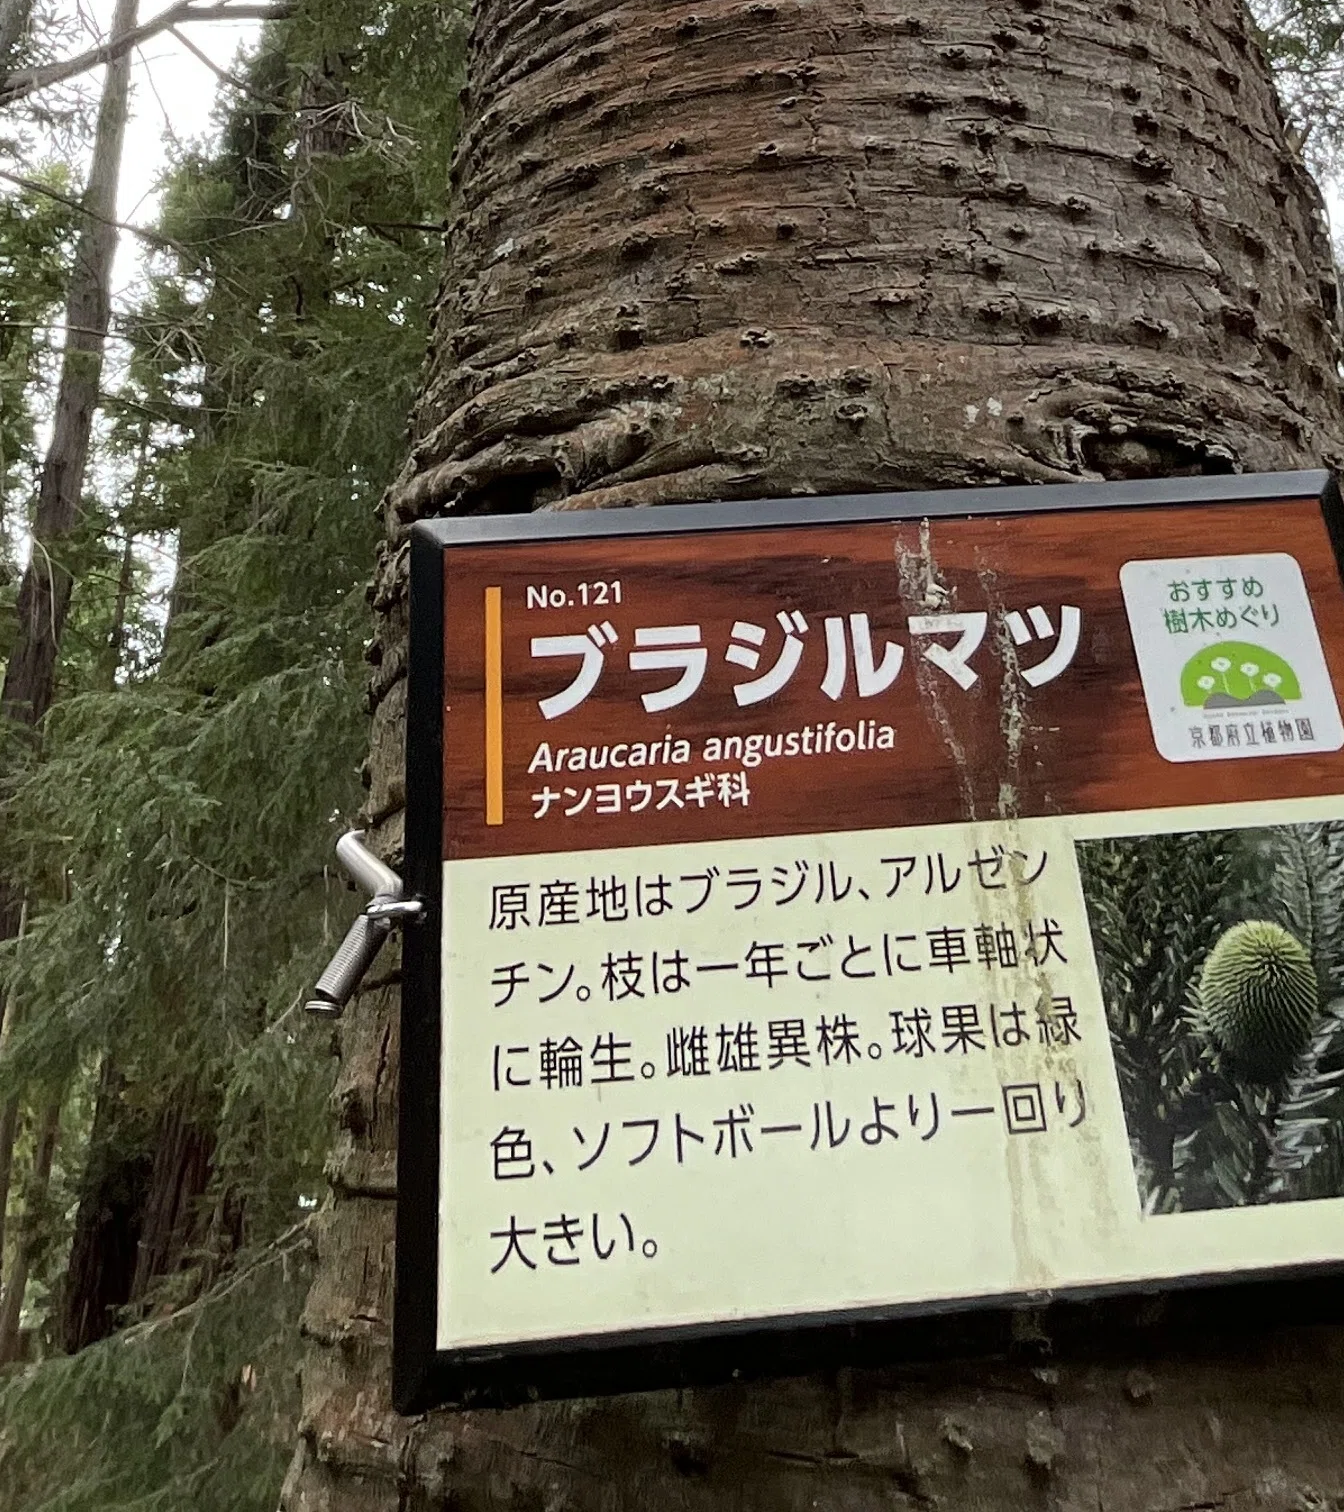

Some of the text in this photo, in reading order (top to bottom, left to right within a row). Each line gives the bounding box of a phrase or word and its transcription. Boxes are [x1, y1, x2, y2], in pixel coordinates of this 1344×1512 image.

[526, 581, 623, 609] No.121
[1163, 603, 1280, 634] 樹木めぐり
[1167, 576, 1264, 602] おすすめ
[530, 605, 1082, 720] ブラジルマツ
[528, 720, 896, 774] Araucaria angustifolia
[530, 772, 751, 819] ナンヨウスギ科
[488, 844, 1049, 930] 原産地はブラジル、アルゼン
[491, 918, 1069, 1008] チン。枝は一年ごとに車軸状
[493, 997, 1083, 1092] に輪生。雌雄異株。球果は緑
[490, 1080, 1087, 1181] 色、ソフトボールより一回り
[489, 1212, 658, 1275] 大きい。
